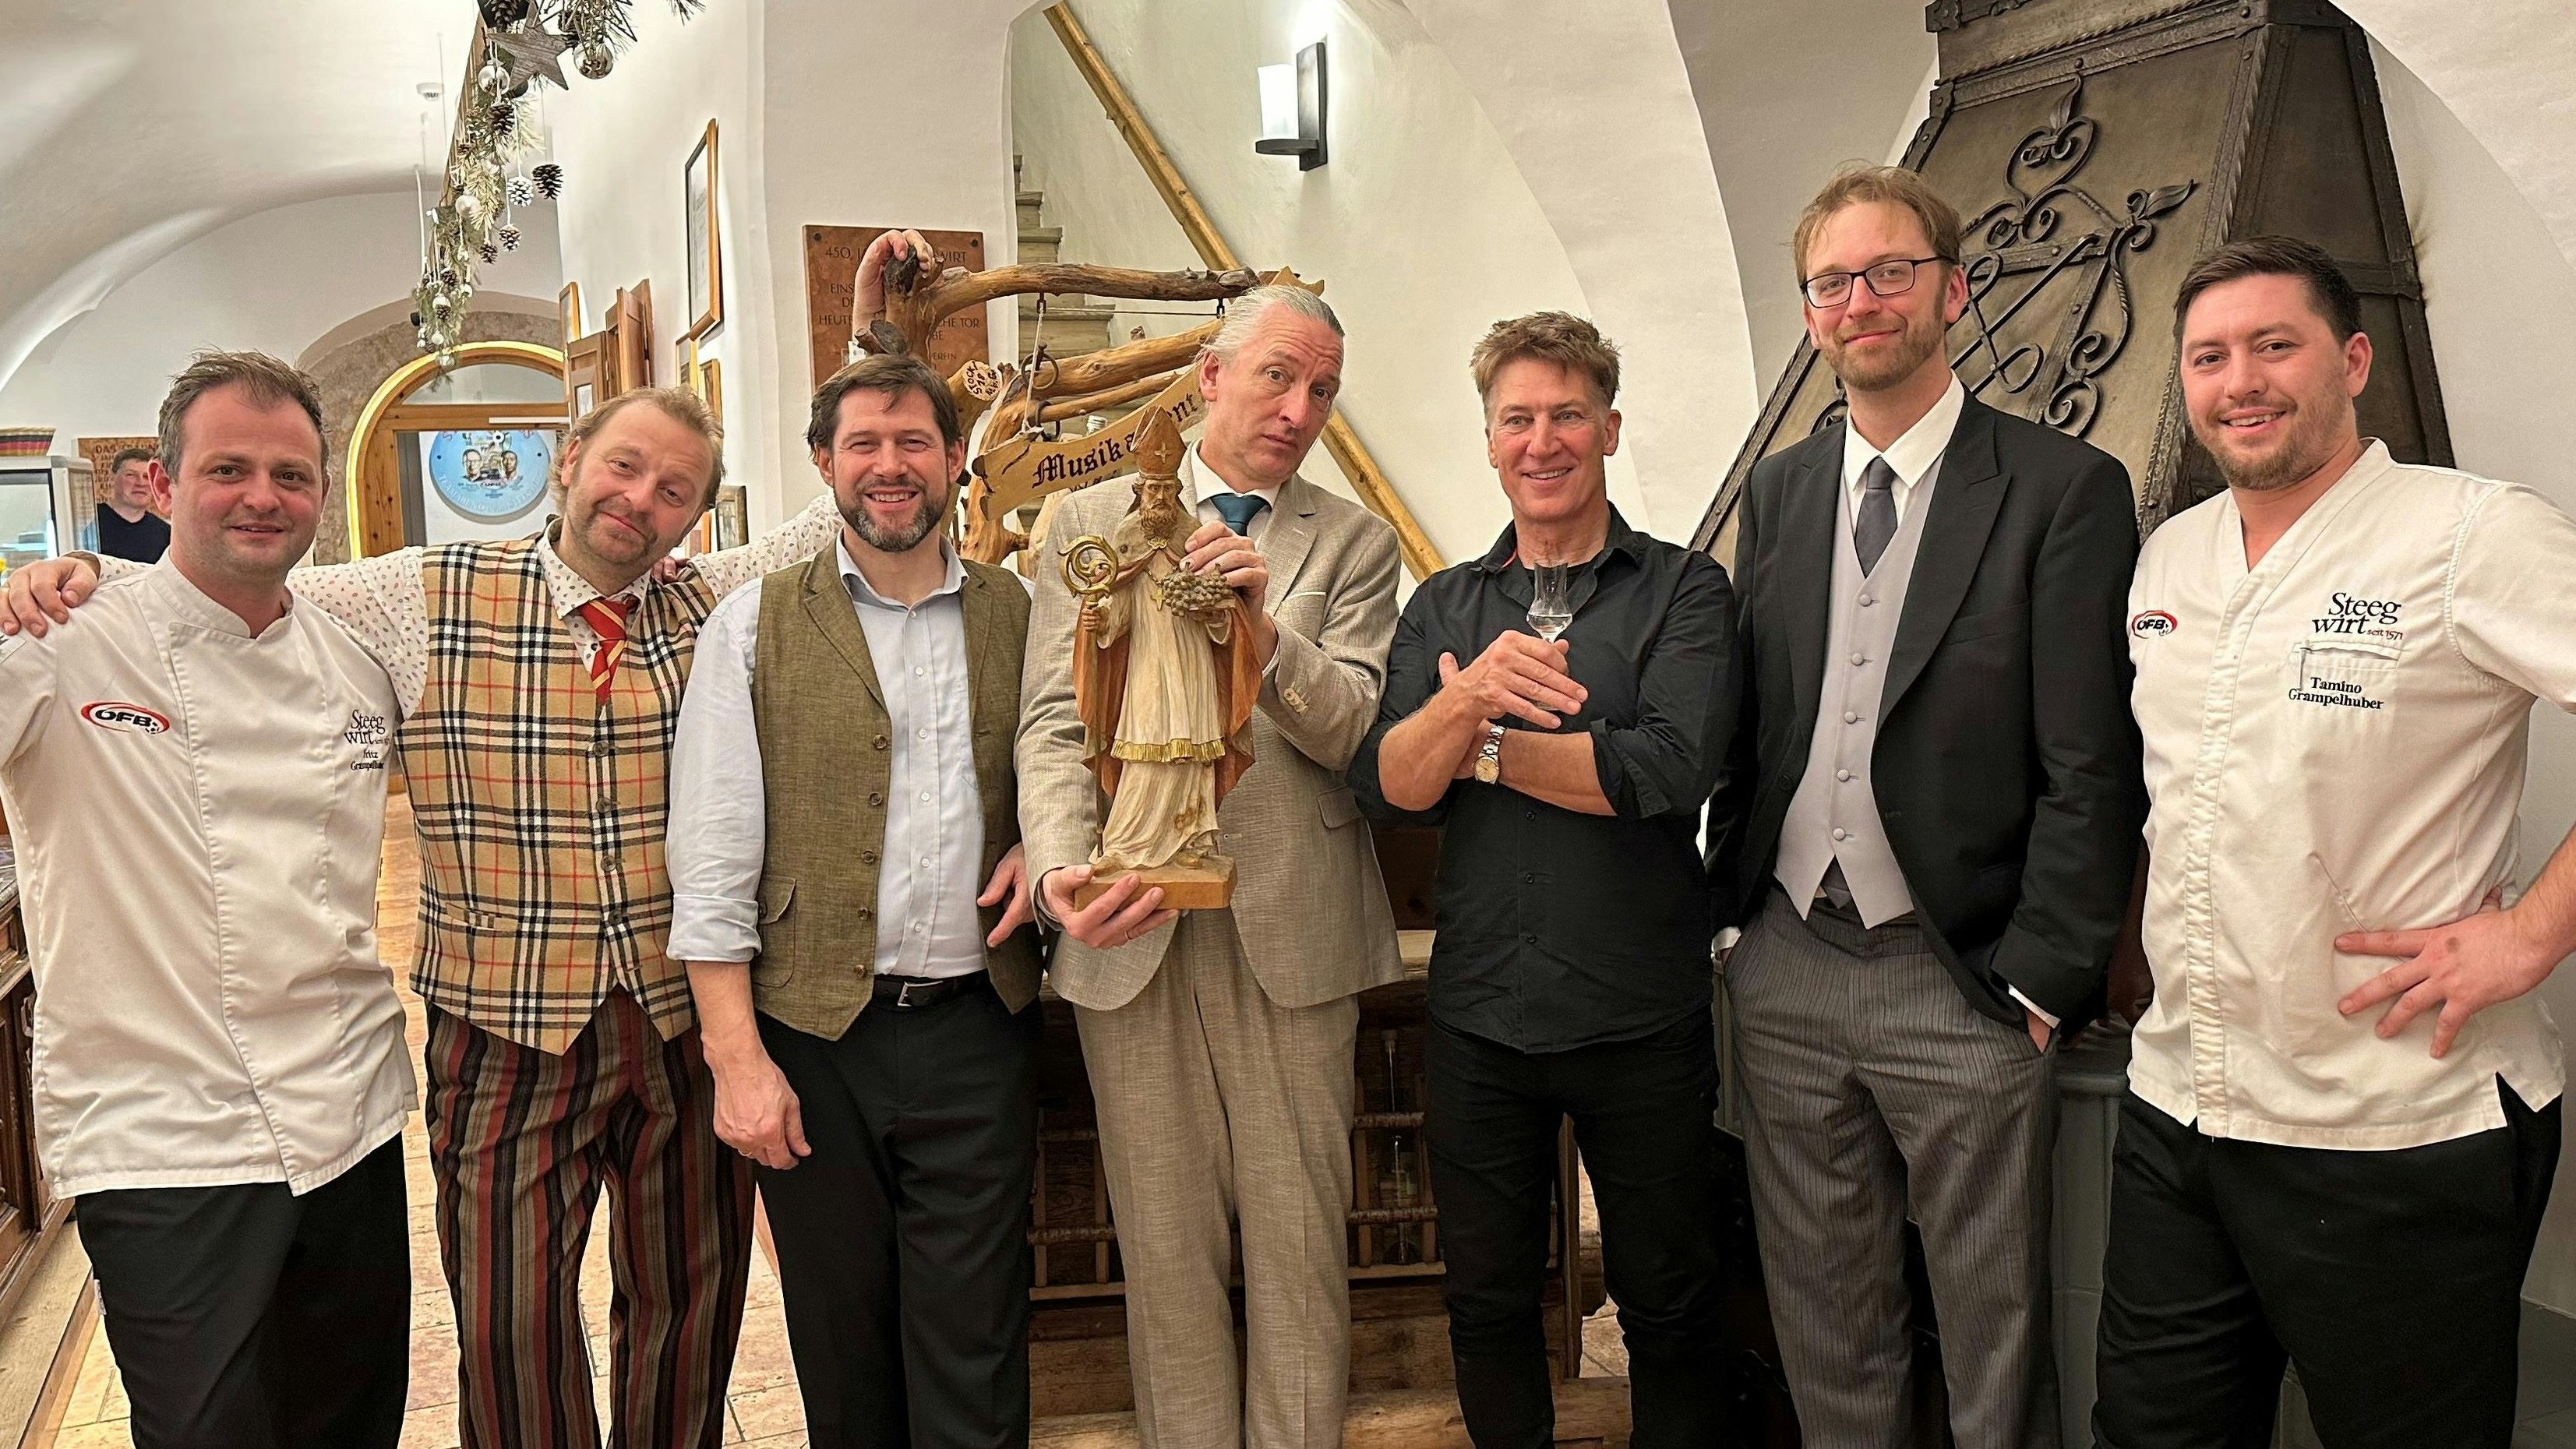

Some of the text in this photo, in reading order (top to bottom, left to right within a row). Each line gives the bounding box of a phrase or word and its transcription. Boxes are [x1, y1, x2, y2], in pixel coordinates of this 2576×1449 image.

[959, 317, 980, 327] TOR
[2328, 592, 2402, 625] Steeg
[2312, 614, 2370, 634] wirt
[2385, 629, 2404, 640] 1571
[2310, 676, 2363, 694] Tamino
[2288, 688, 2384, 709] Grampelhuber
[351, 709, 386, 735] Steeg
[344, 728, 375, 745] wirt
